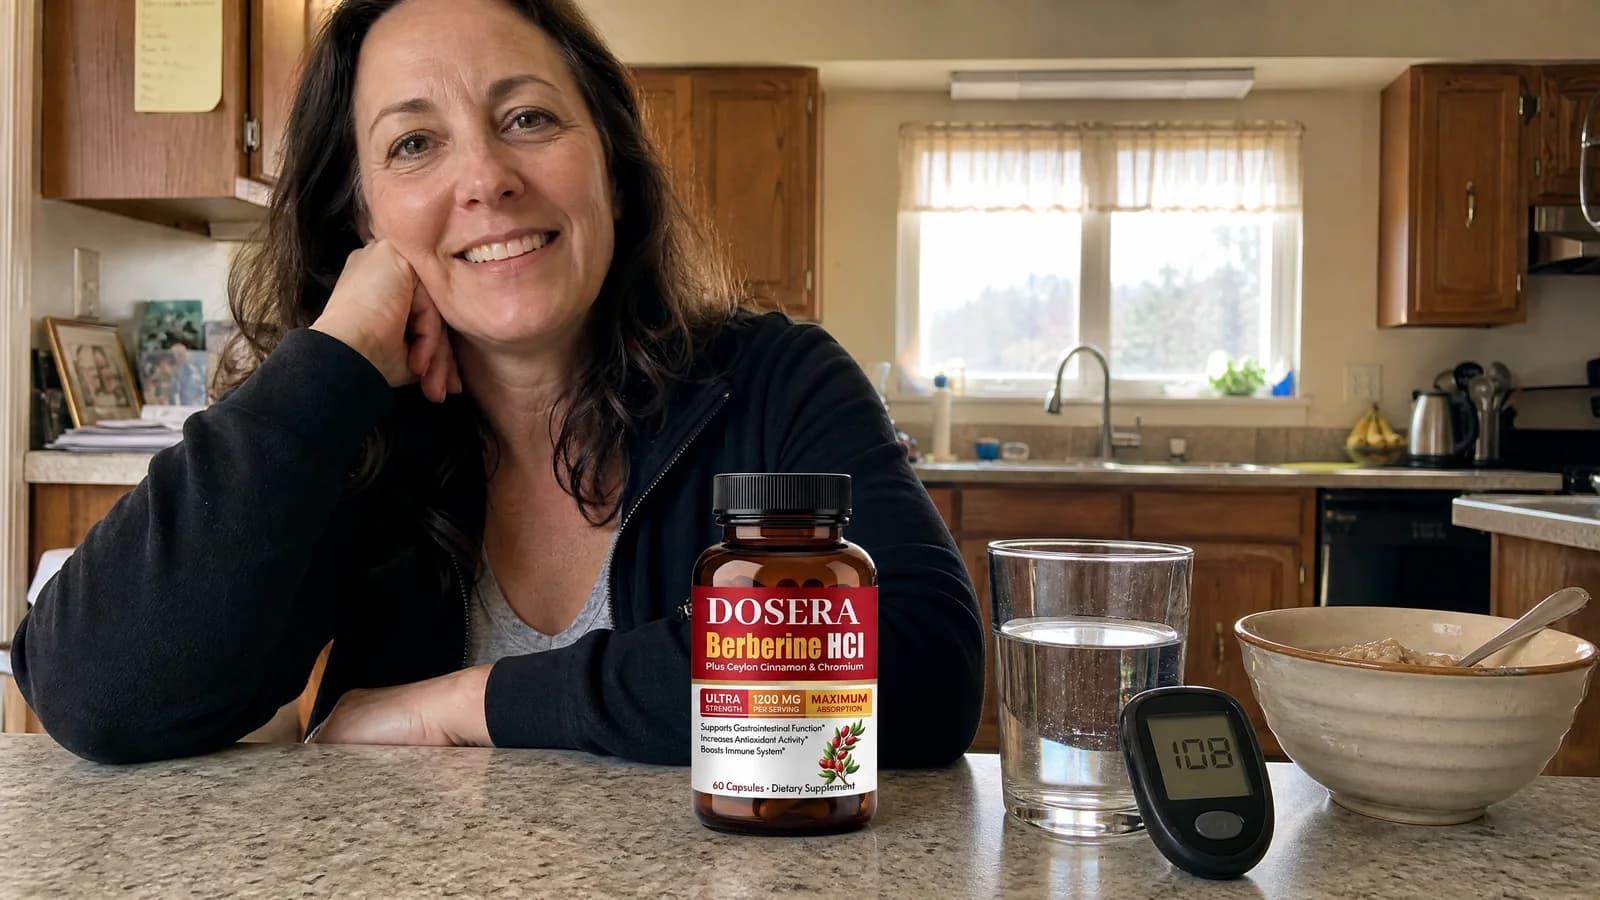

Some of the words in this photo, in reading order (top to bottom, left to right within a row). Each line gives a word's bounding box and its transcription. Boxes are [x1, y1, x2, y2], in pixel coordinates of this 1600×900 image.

[706, 598, 860, 625] DOSERA
[706, 632, 822, 659] Berberine
[706, 662, 724, 671] Plus
[727, 663, 758, 672] Ceylon
[760, 663, 807, 672] Cinnamon
[810, 663, 816, 672] &
[818, 662, 864, 671] Chromium
[706, 693, 741, 704] ULTRA
[753, 694, 779, 705] 1200
[782, 695, 801, 705] MG
[811, 693, 868, 705] MAXIMUM
[706, 705, 742, 713] STRENGTH
[816, 705, 862, 713] ABSORPTION
[701, 723, 732, 733] Supports
[733, 724, 790, 733] Gastrointestinal
[701, 734, 733, 743] Increases
[734, 735, 776, 744] Antioxidant
[701, 745, 723, 754] Boosts
[725, 746, 755, 755] Immune
[1172, 737, 1235, 770] 108
[712, 781, 724, 790] 60
[726, 782, 764, 793] Capsules
[771, 783, 802, 793] Dietary
[804, 782, 855, 793] Supplement
